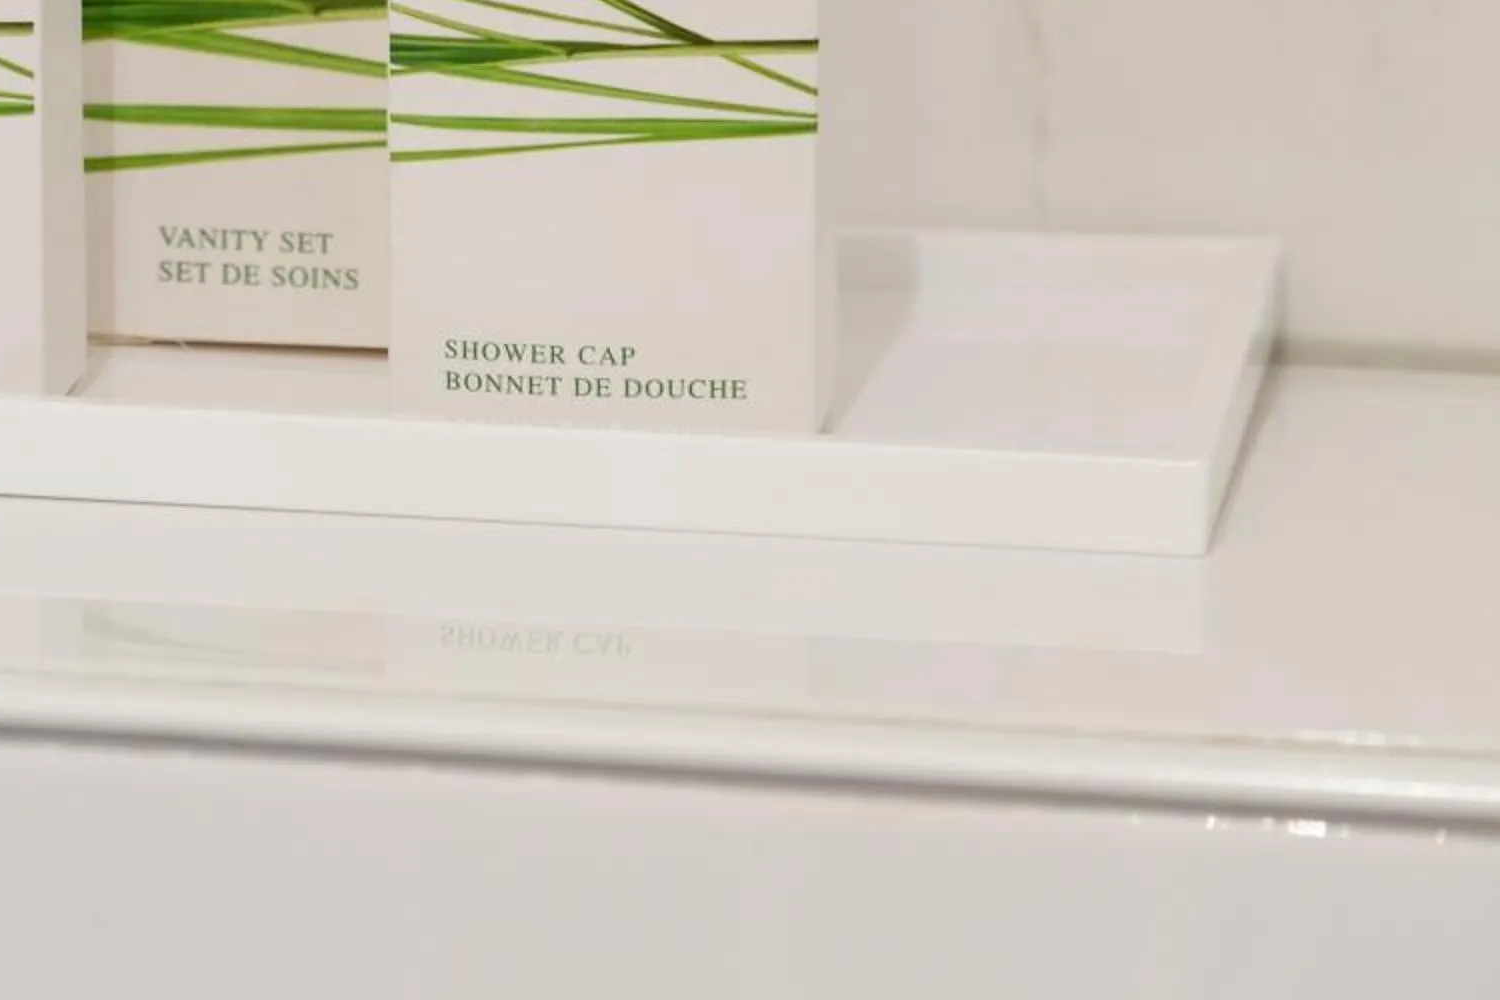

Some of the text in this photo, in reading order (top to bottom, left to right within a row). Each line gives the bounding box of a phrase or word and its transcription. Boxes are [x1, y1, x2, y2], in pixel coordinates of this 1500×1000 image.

[158, 225, 335, 256] VANITY SET
[158, 260, 361, 291] SET DE SOINS
[444, 338, 638, 368] SHOWER CAP
[445, 371, 750, 401] BONNET DE DOUCHE
